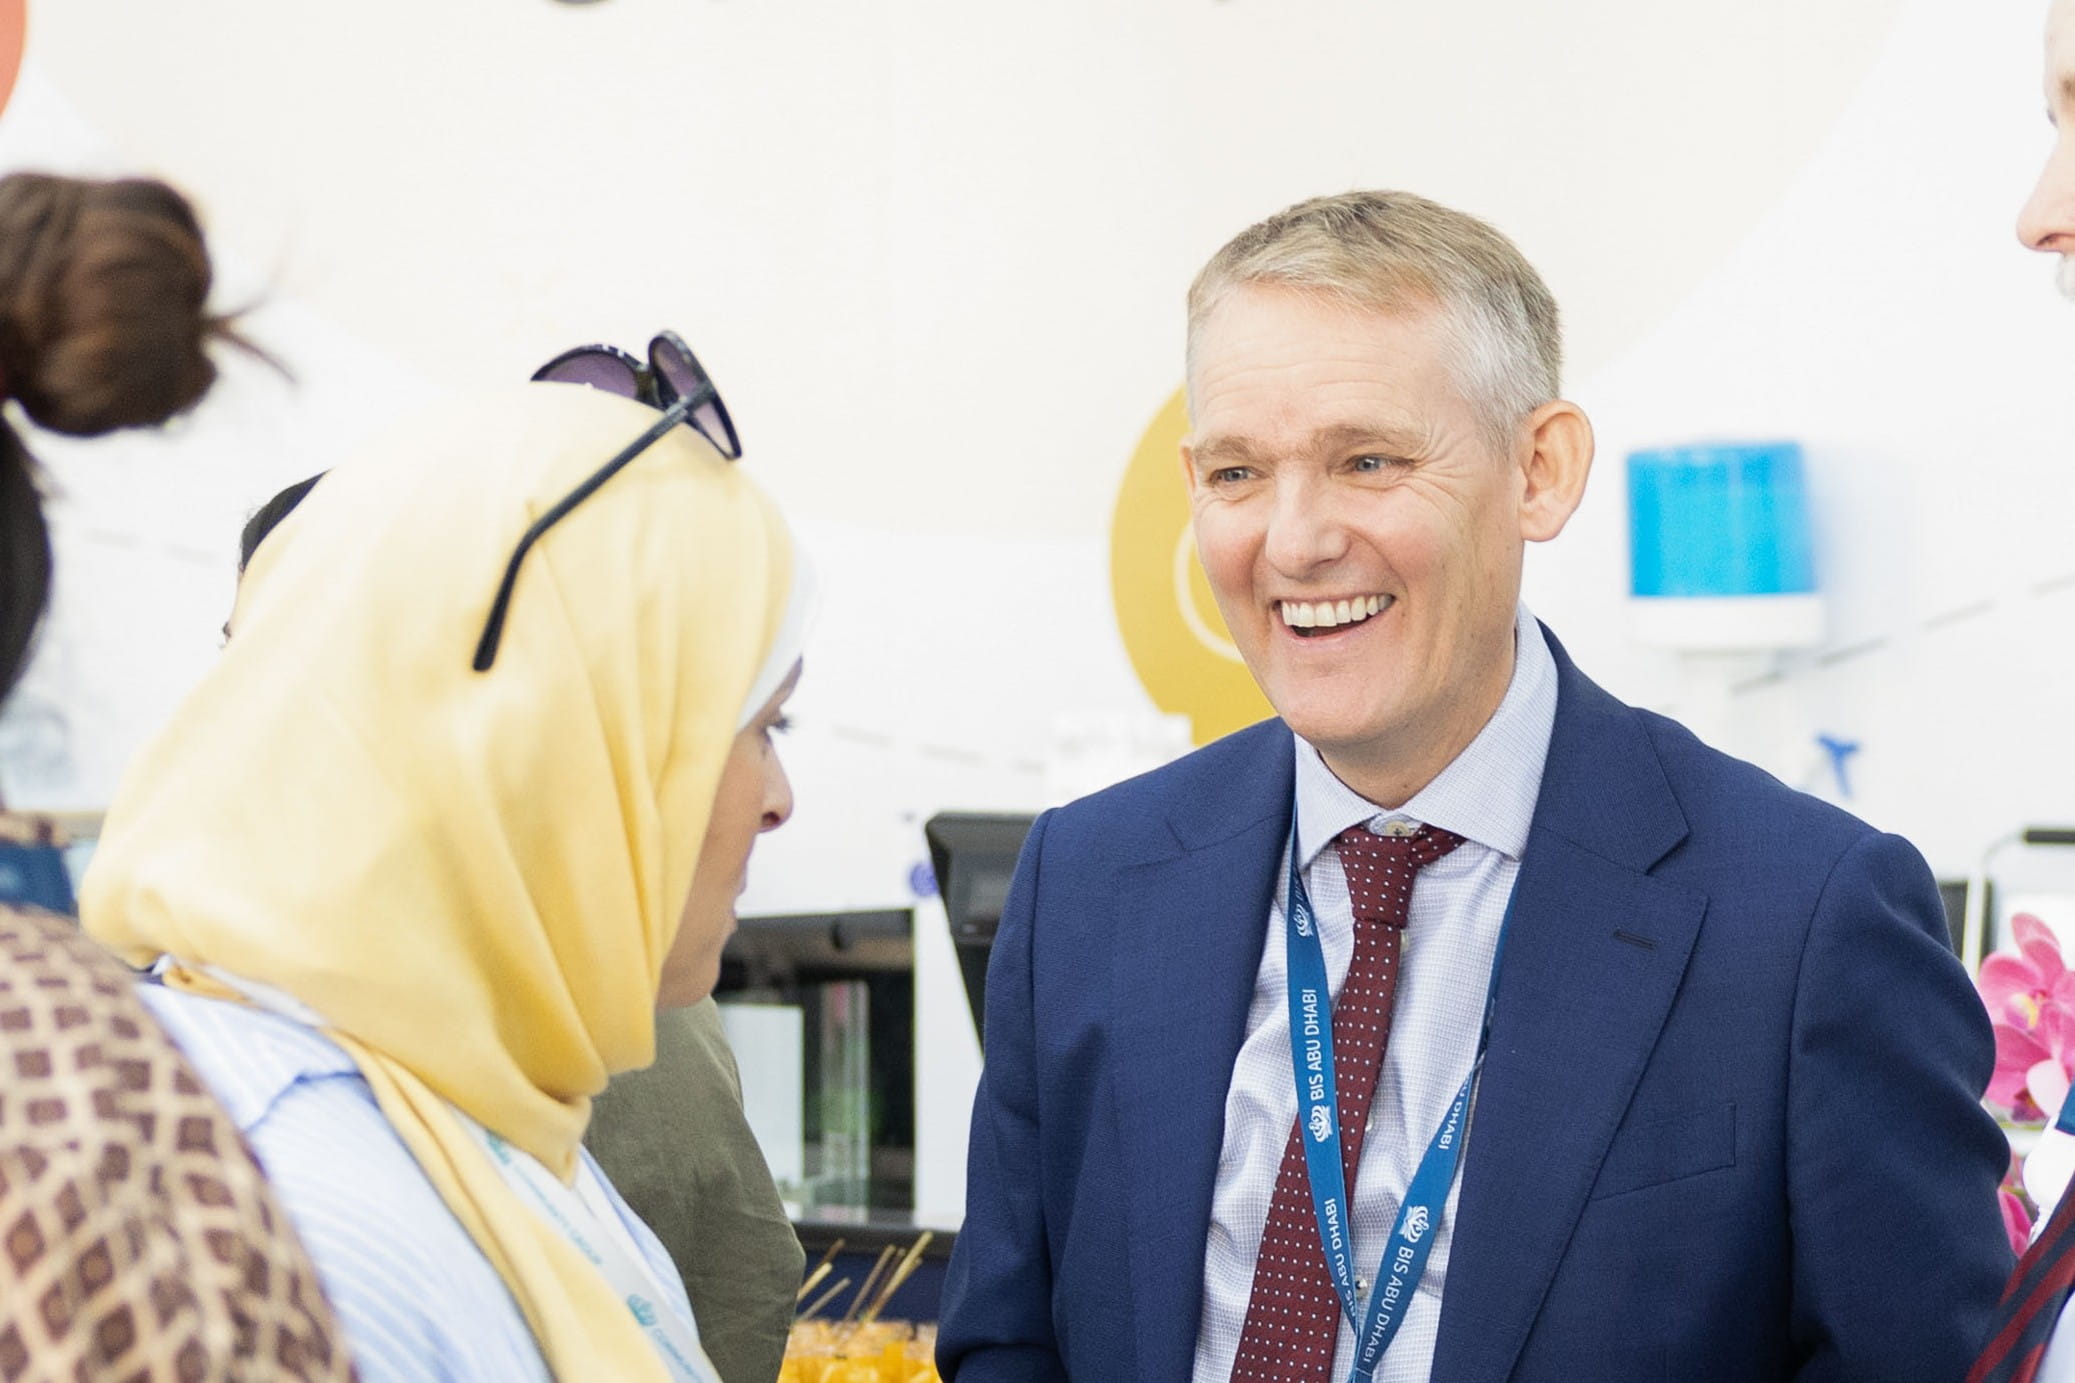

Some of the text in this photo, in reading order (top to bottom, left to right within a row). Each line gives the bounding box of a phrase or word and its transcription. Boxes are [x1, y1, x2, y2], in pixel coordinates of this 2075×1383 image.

[1302, 989, 1325, 1101] BIS ABU DHABI
[1438, 1101, 1463, 1150] DHABI
[1324, 1198, 1342, 1250] DHABI
[1335, 1253, 1350, 1286] ABU
[1363, 1246, 1415, 1363] BIS ABU DHABI
